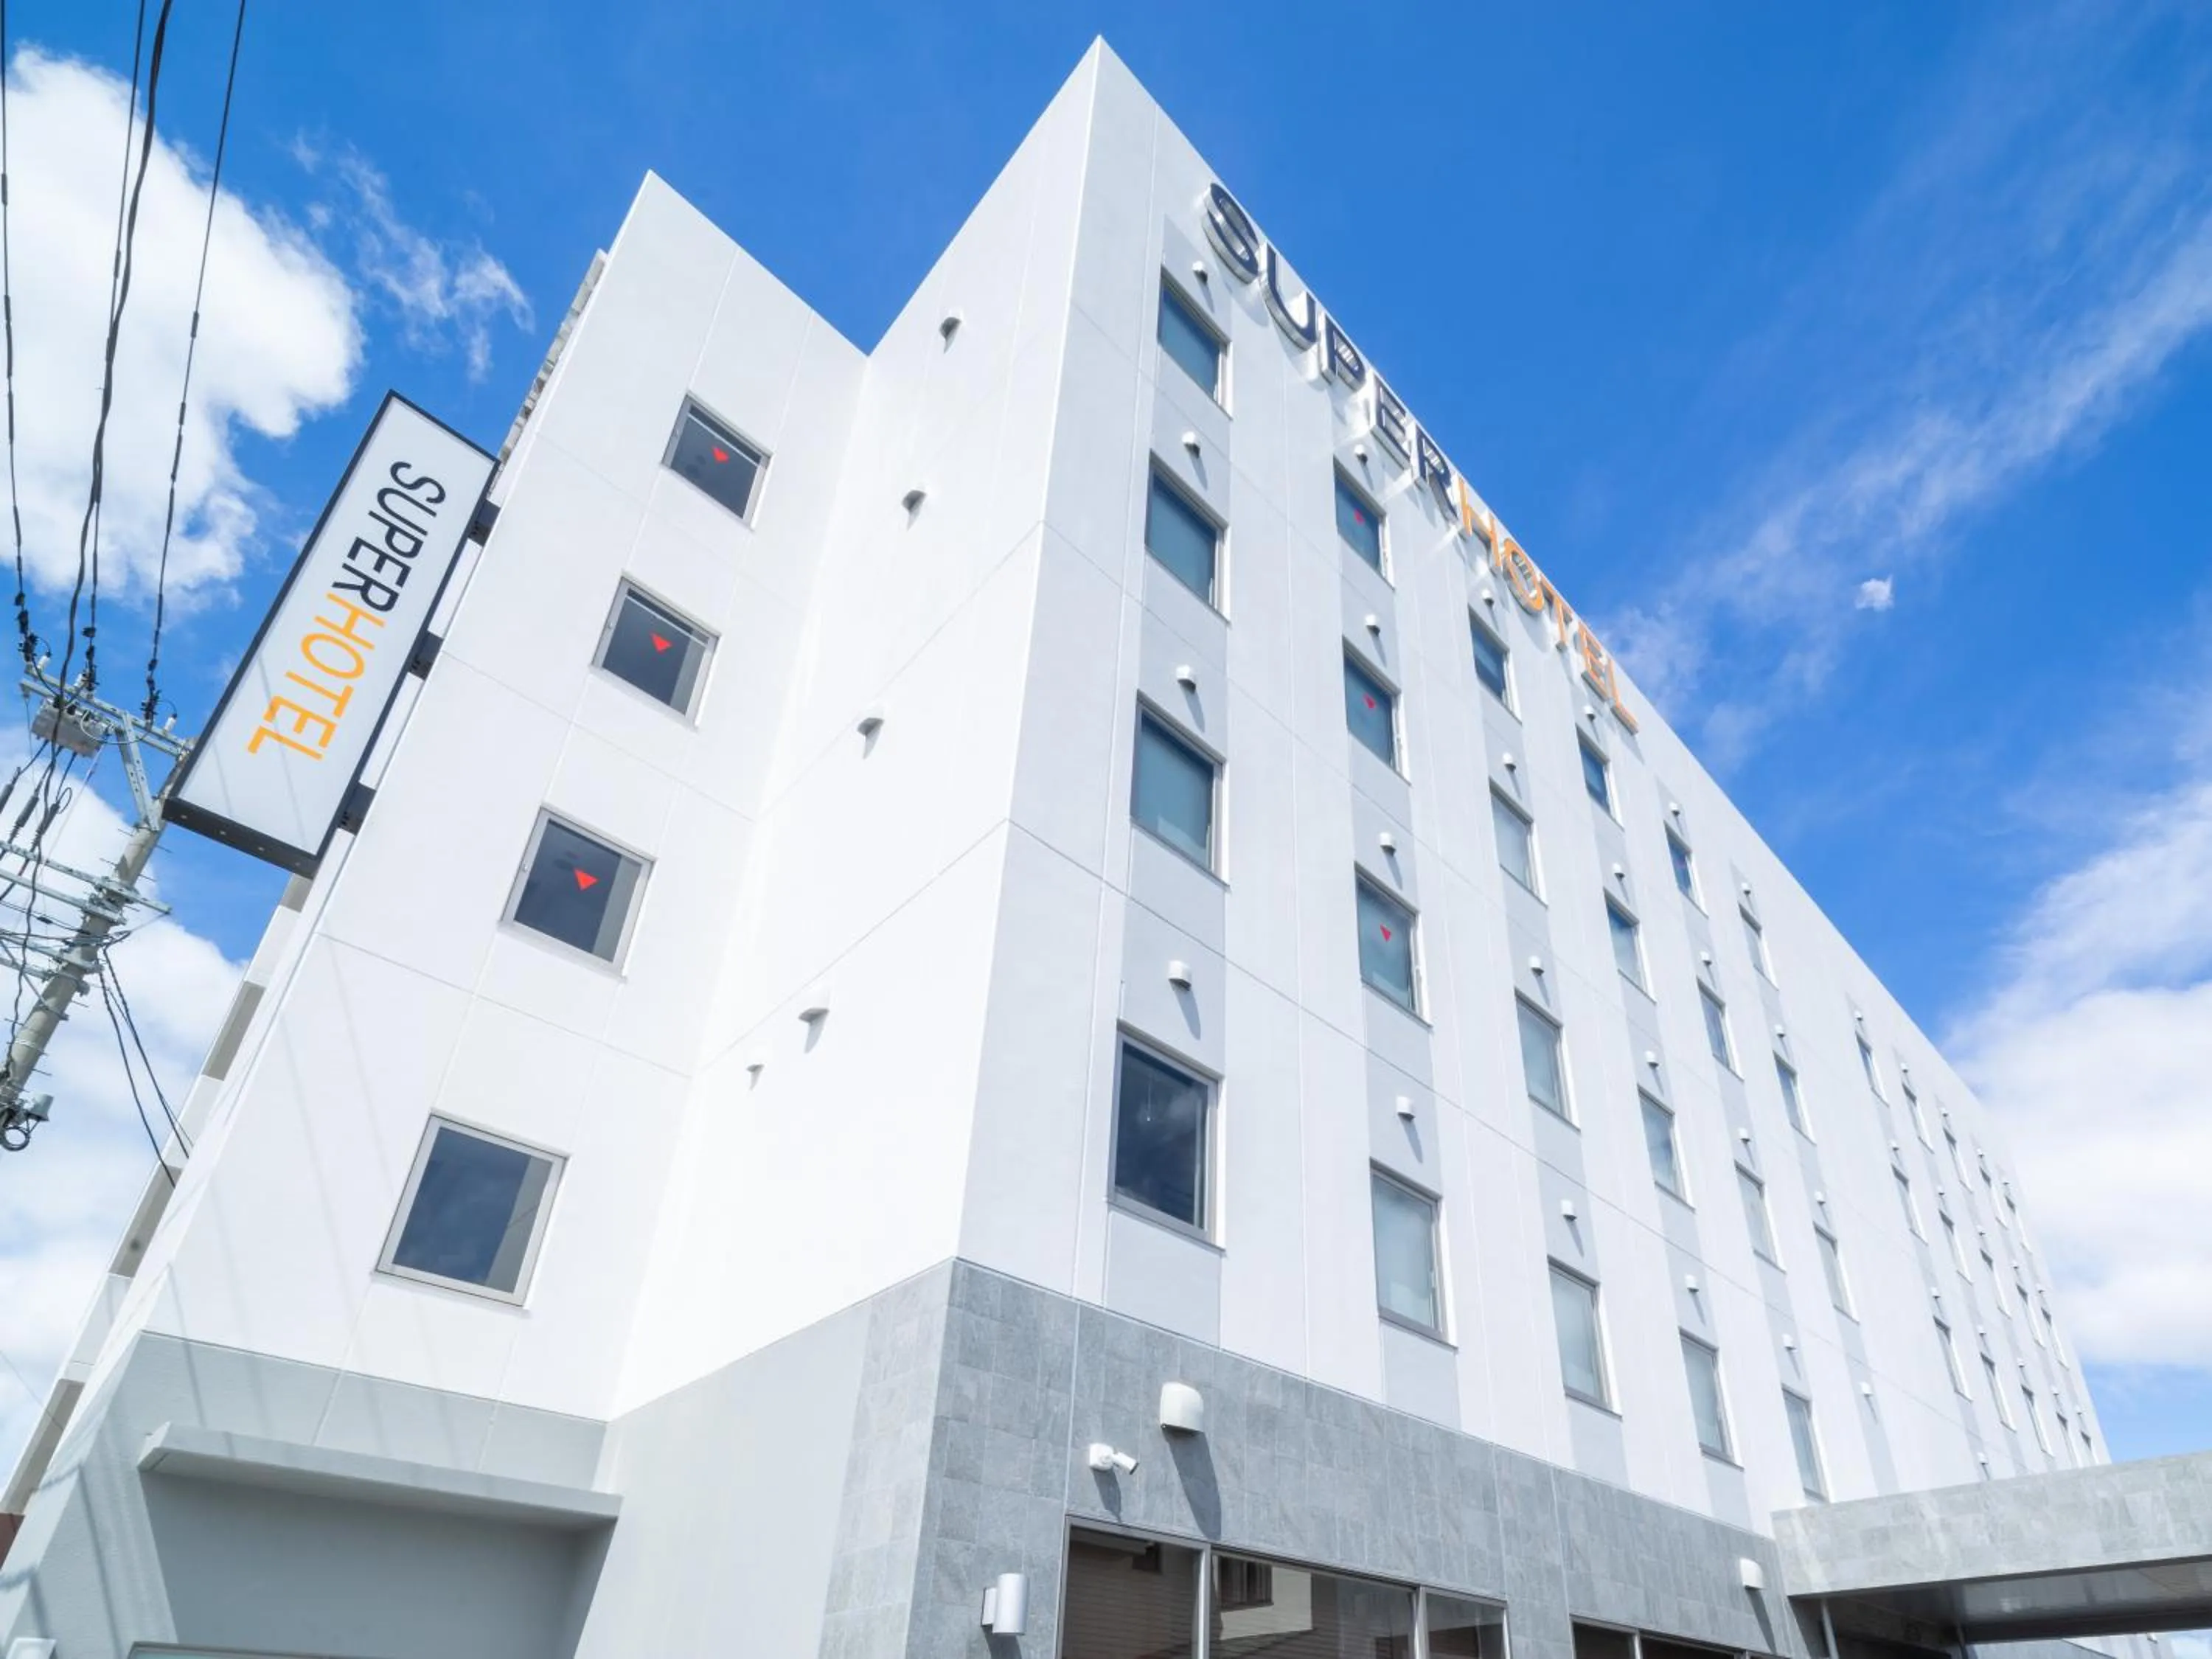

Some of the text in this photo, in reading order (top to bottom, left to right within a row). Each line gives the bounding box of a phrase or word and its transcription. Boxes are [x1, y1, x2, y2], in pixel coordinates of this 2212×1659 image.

[247, 460, 446, 760] SUPER HOTEL
[1205, 183, 1638, 735] SUPER HOTEL
